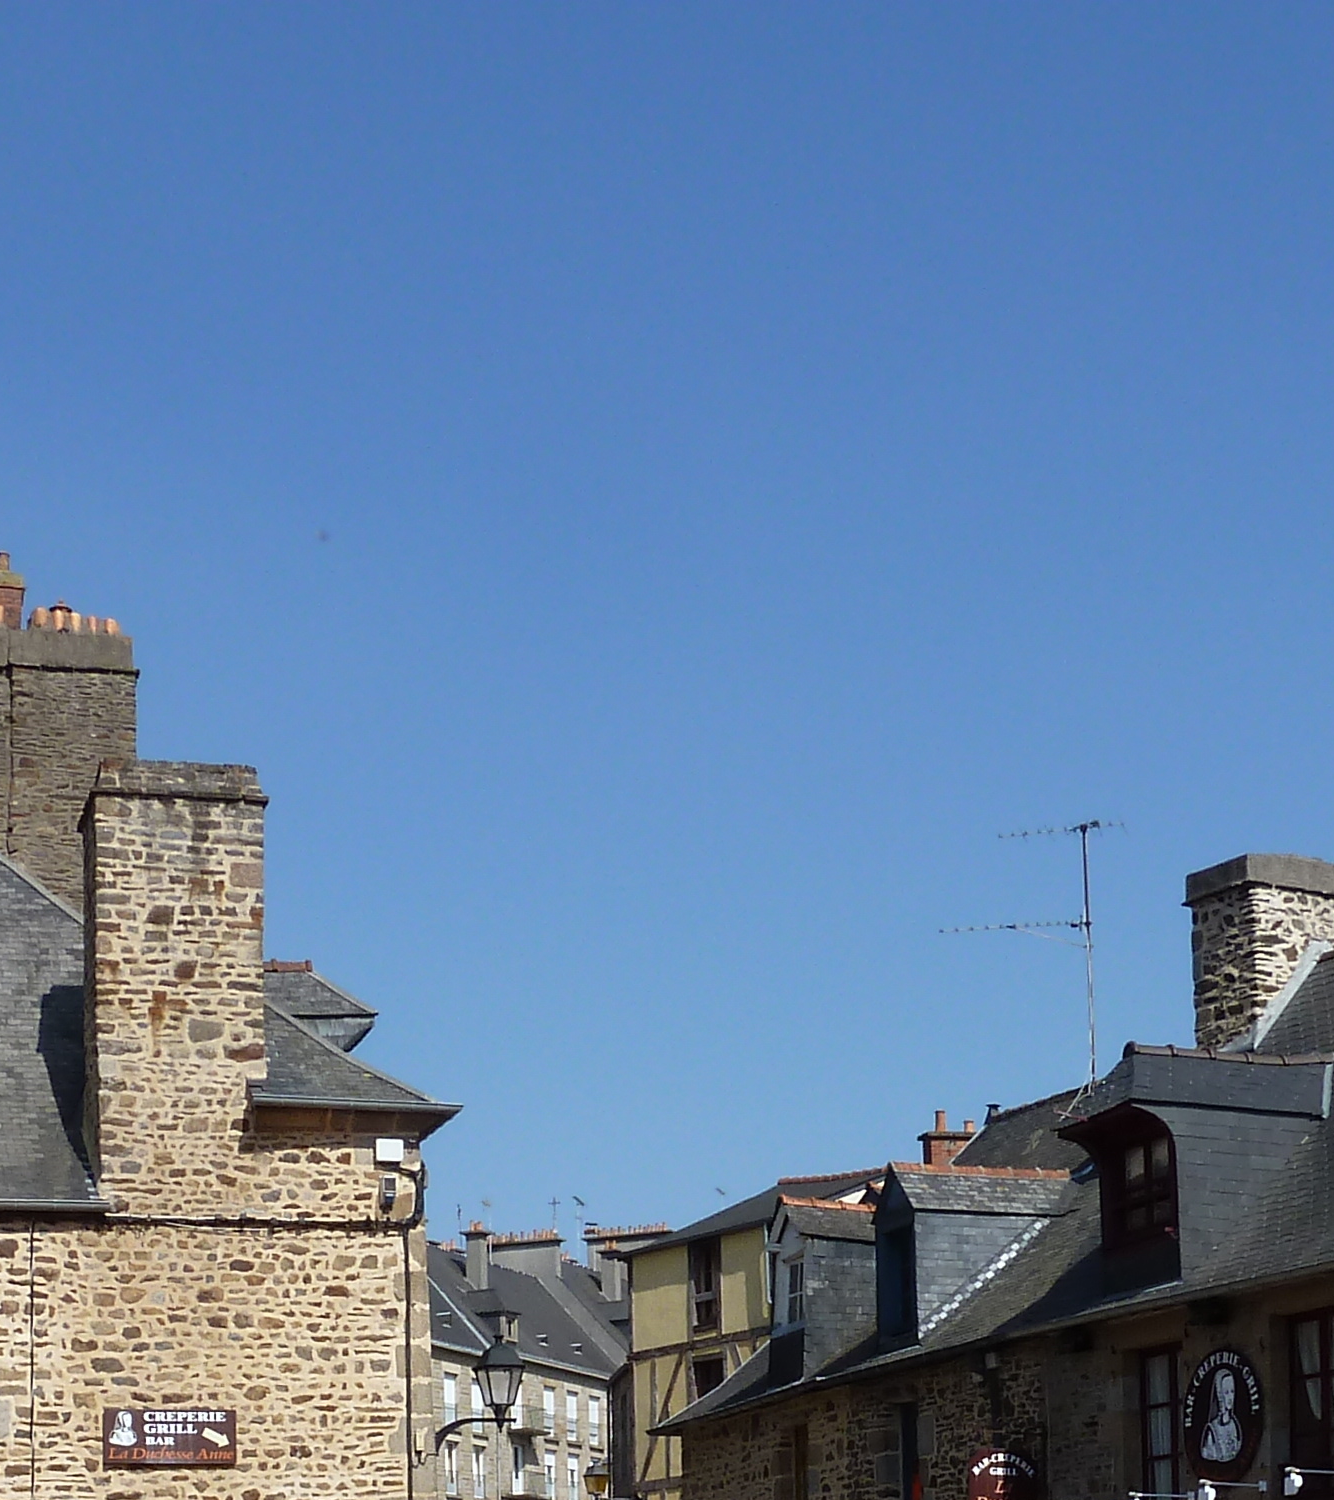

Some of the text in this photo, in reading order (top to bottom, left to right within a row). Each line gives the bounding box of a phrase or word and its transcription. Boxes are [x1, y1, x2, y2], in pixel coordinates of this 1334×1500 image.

[143, 1411, 227, 1422] CREPERIE
[143, 1423, 198, 1434] GRILL
[145, 1436, 175, 1446] BAR
[108, 1446, 235, 1460] La Duchesse Anne
[989, 1467, 1017, 1476] GRILL
